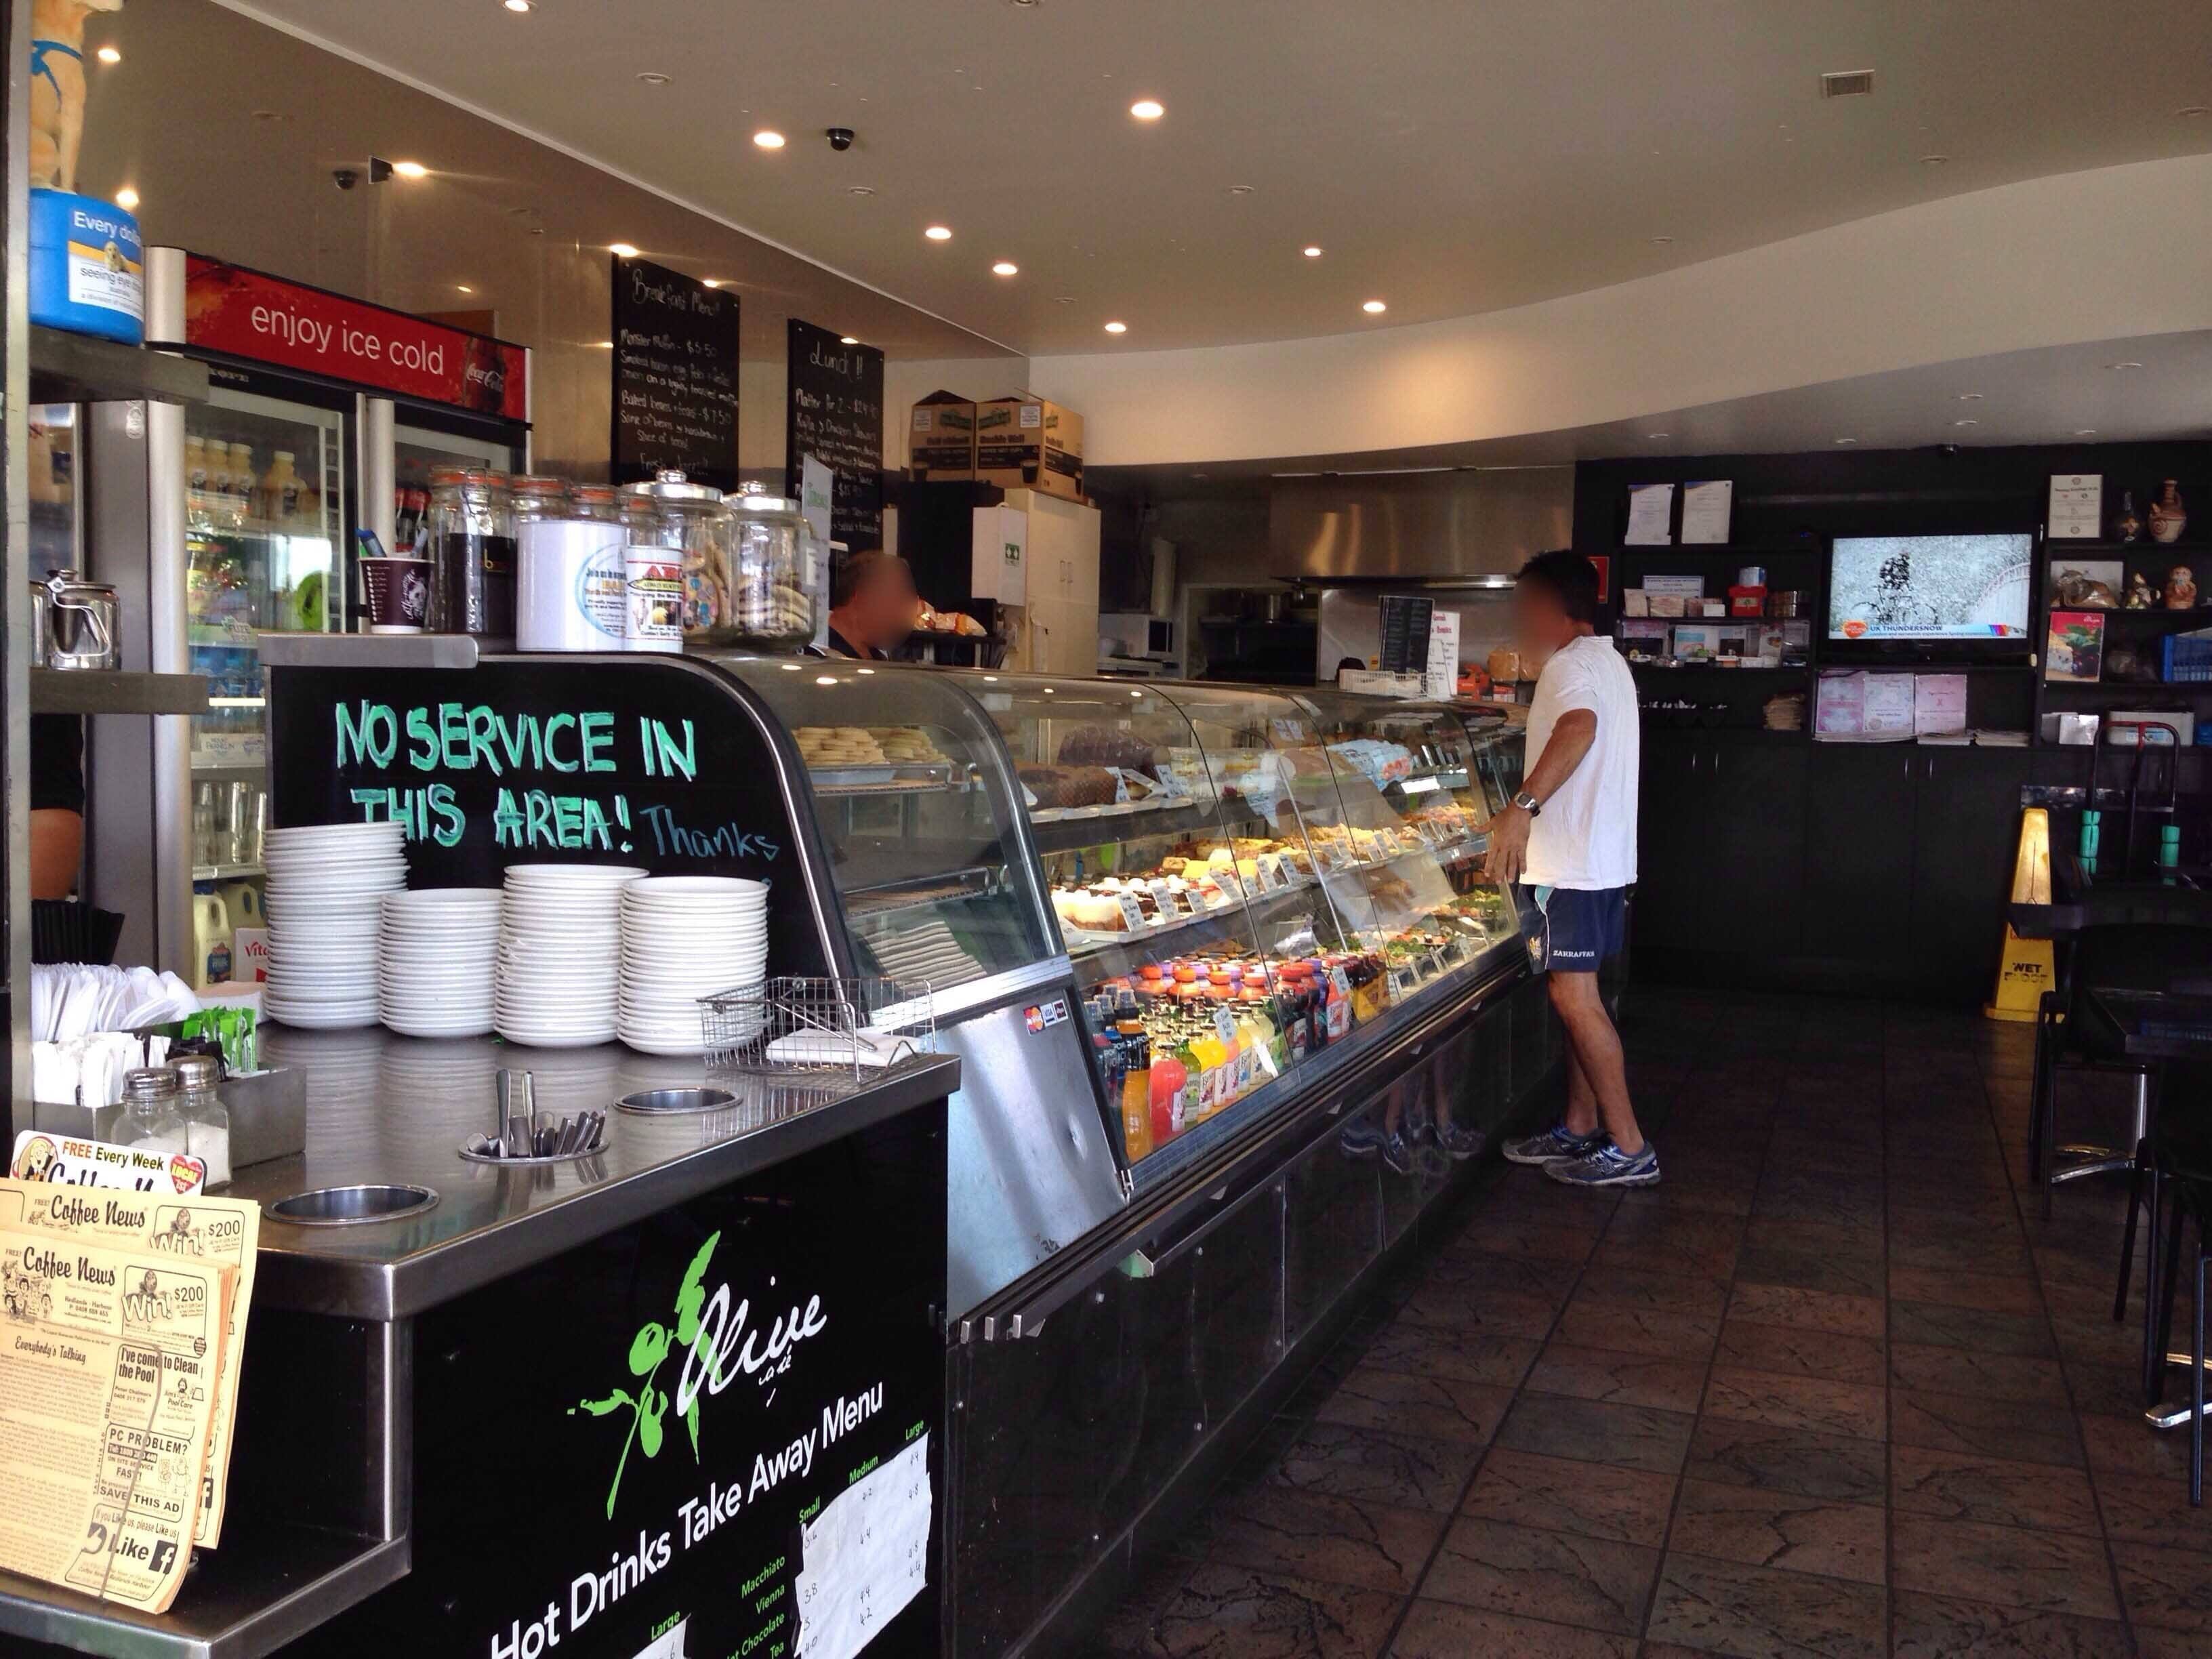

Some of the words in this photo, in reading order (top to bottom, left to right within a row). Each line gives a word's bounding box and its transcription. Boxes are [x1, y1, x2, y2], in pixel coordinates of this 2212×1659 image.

[74, 211, 118, 239] Every
[251, 305, 333, 354] enjoy
[342, 319, 382, 361] ice
[388, 340, 445, 375] cold
[336, 699, 398, 770] NO
[407, 702, 617, 777] SERVICE
[640, 716, 697, 783] IN
[349, 783, 466, 848] THIS
[493, 788, 633, 854] AREA!
[639, 804, 780, 862] Thanks
[2012, 962, 2043, 973] WET
[62, 1141, 93, 1159] FREE
[96, 1147, 129, 1168] Every
[132, 1153, 165, 1172] Week
[51, 1194, 100, 1226] Coffee
[106, 1200, 146, 1229] News
[207, 1219, 241, 1237] $200
[23, 1246, 73, 1279] Coffee
[77, 1256, 116, 1287] News
[121, 1292, 173, 1323] Win!
[174, 1286, 204, 1303] $200
[15, 1335, 56, 1359] Everybody's
[60, 1345, 87, 1366] Talking
[121, 1347, 136, 1363] I've
[136, 1352, 159, 1368] come
[163, 1355, 173, 1370] to
[173, 1356, 199, 1375] Clean
[118, 1363, 134, 1379] the
[134, 1365, 156, 1383] Pool
[167, 1397, 180, 1407] Pool
[109, 1427, 125, 1441] PC
[905, 1419, 925, 1441] Large
[848, 1454, 880, 1486] Medium
[100, 1486, 129, 1500] SAVE
[134, 1493, 161, 1509] THIS
[163, 1501, 180, 1513] AD
[798, 1496, 821, 1525] Small
[155, 1522, 169, 1536] Like
[169, 1528, 178, 1538] us
[491, 1601, 560, 1659] Hot
[571, 1529, 672, 1633] Drinks
[678, 1481, 742, 1550] Take
[747, 1427, 817, 1504] Away
[823, 1380, 883, 1449] Menu
[107, 1533, 150, 1561] Like
[740, 1555, 786, 1599] Macchiato
[755, 1584, 785, 1615] Vienna
[651, 1610, 682, 1642] Large
[741, 1612, 785, 1656] Chocolate
[769, 1640, 785, 1659] Tea
